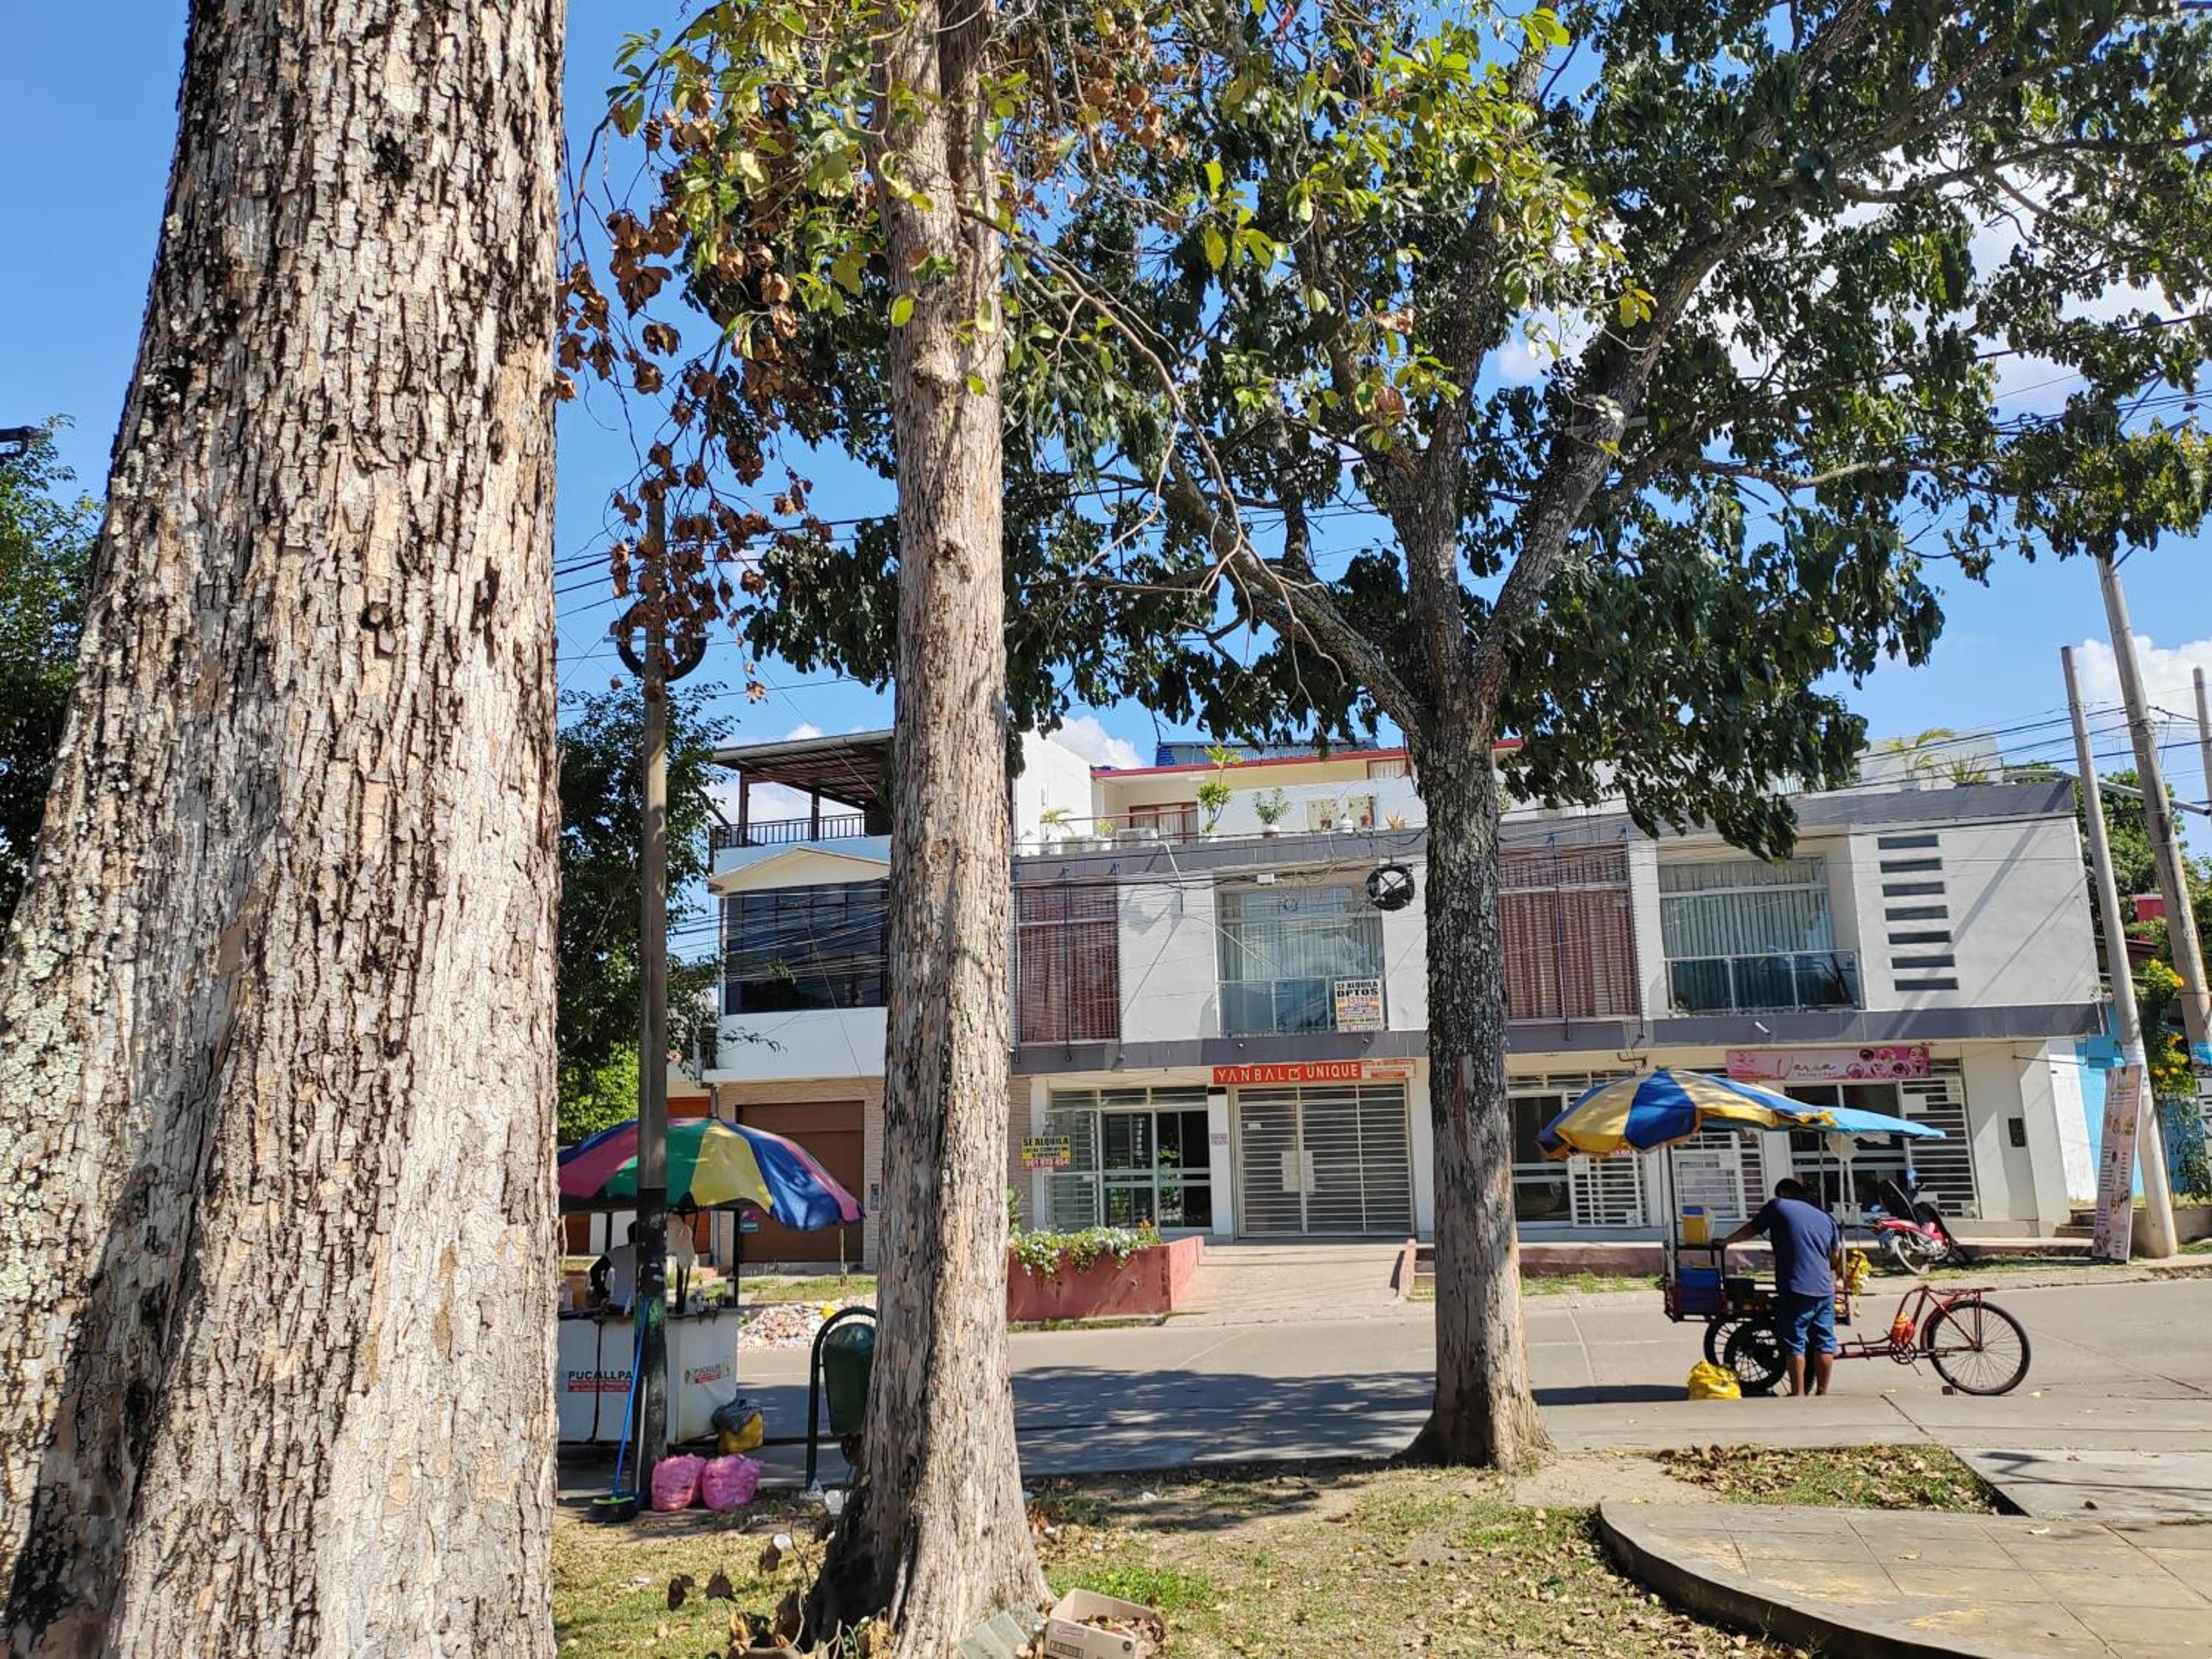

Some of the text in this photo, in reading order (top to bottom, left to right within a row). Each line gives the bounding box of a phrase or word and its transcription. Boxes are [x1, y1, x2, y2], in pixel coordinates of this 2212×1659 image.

[1337, 988, 1378, 997] DPTOS
[1218, 1068, 1284, 1082] YANBAL
[1306, 1064, 1358, 1079] UNIQUE
[1023, 1137, 1068, 1146] SE ALQUILA
[568, 1371, 633, 1380] PUCALLPA
